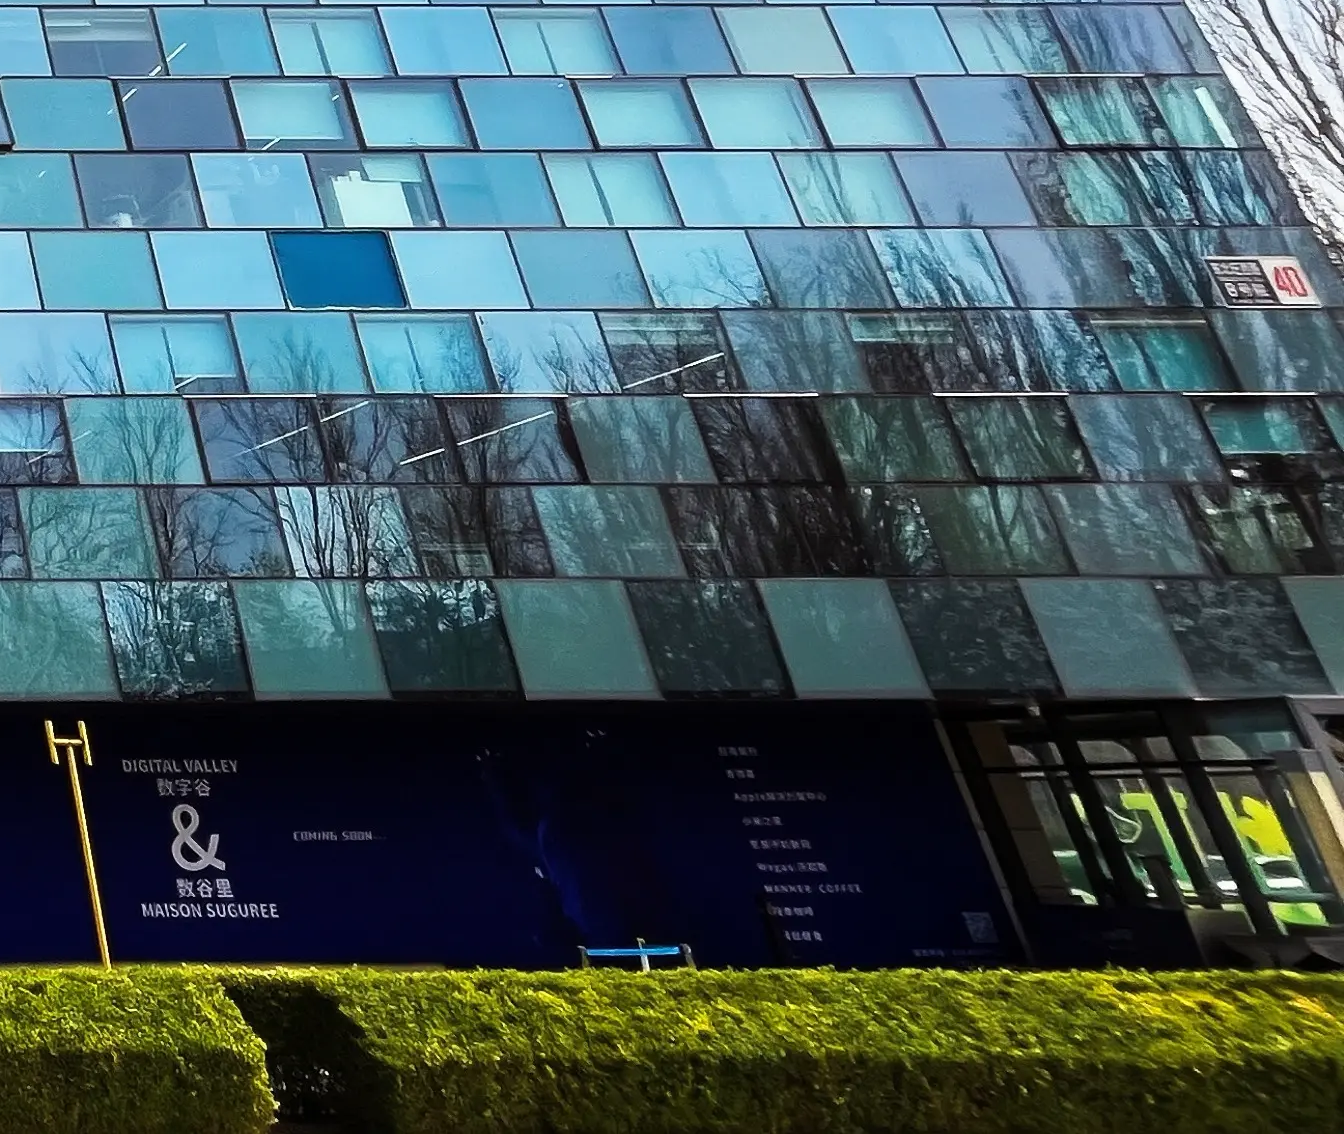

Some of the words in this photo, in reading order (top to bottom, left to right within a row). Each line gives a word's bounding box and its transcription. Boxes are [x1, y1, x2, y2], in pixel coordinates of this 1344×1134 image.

[122, 759, 181, 773] DIGITAL
[183, 759, 238, 773] VALLEY
[156, 778, 211, 797] 数字谷
[171, 803, 226, 872] &
[176, 878, 234, 898] 数谷里
[141, 903, 203, 918] MAISON
[206, 903, 279, 918] SUGUREE
